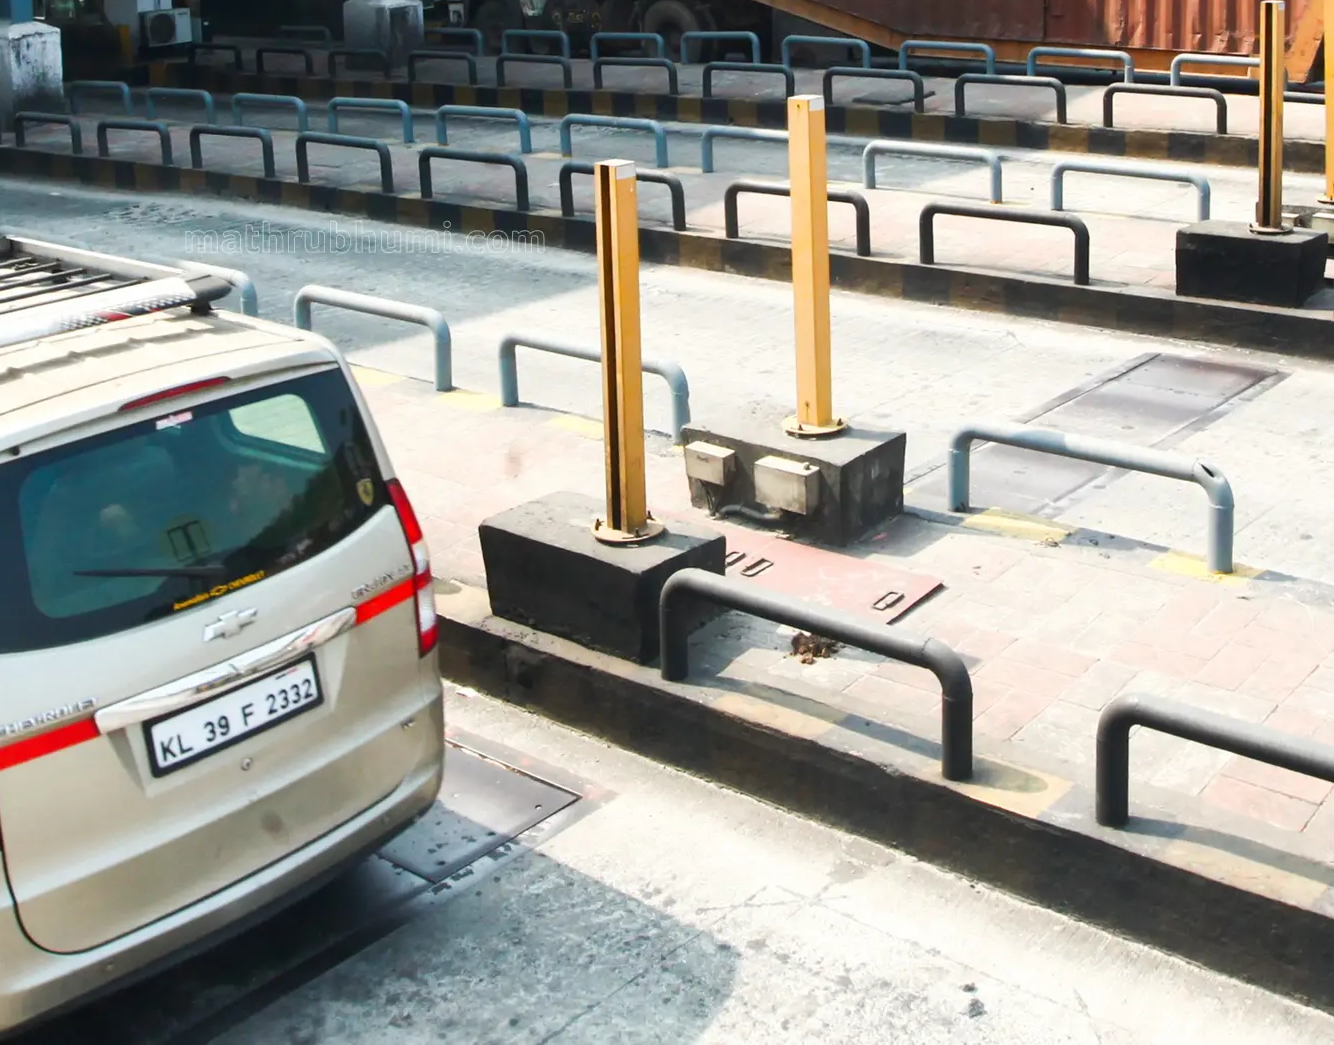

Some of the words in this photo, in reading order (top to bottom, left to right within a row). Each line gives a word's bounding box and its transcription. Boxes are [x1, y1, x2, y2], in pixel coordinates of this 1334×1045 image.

[160, 733, 193, 762] KL
[203, 715, 231, 743] 39
[240, 702, 255, 727] F
[265, 678, 314, 716] 2332
